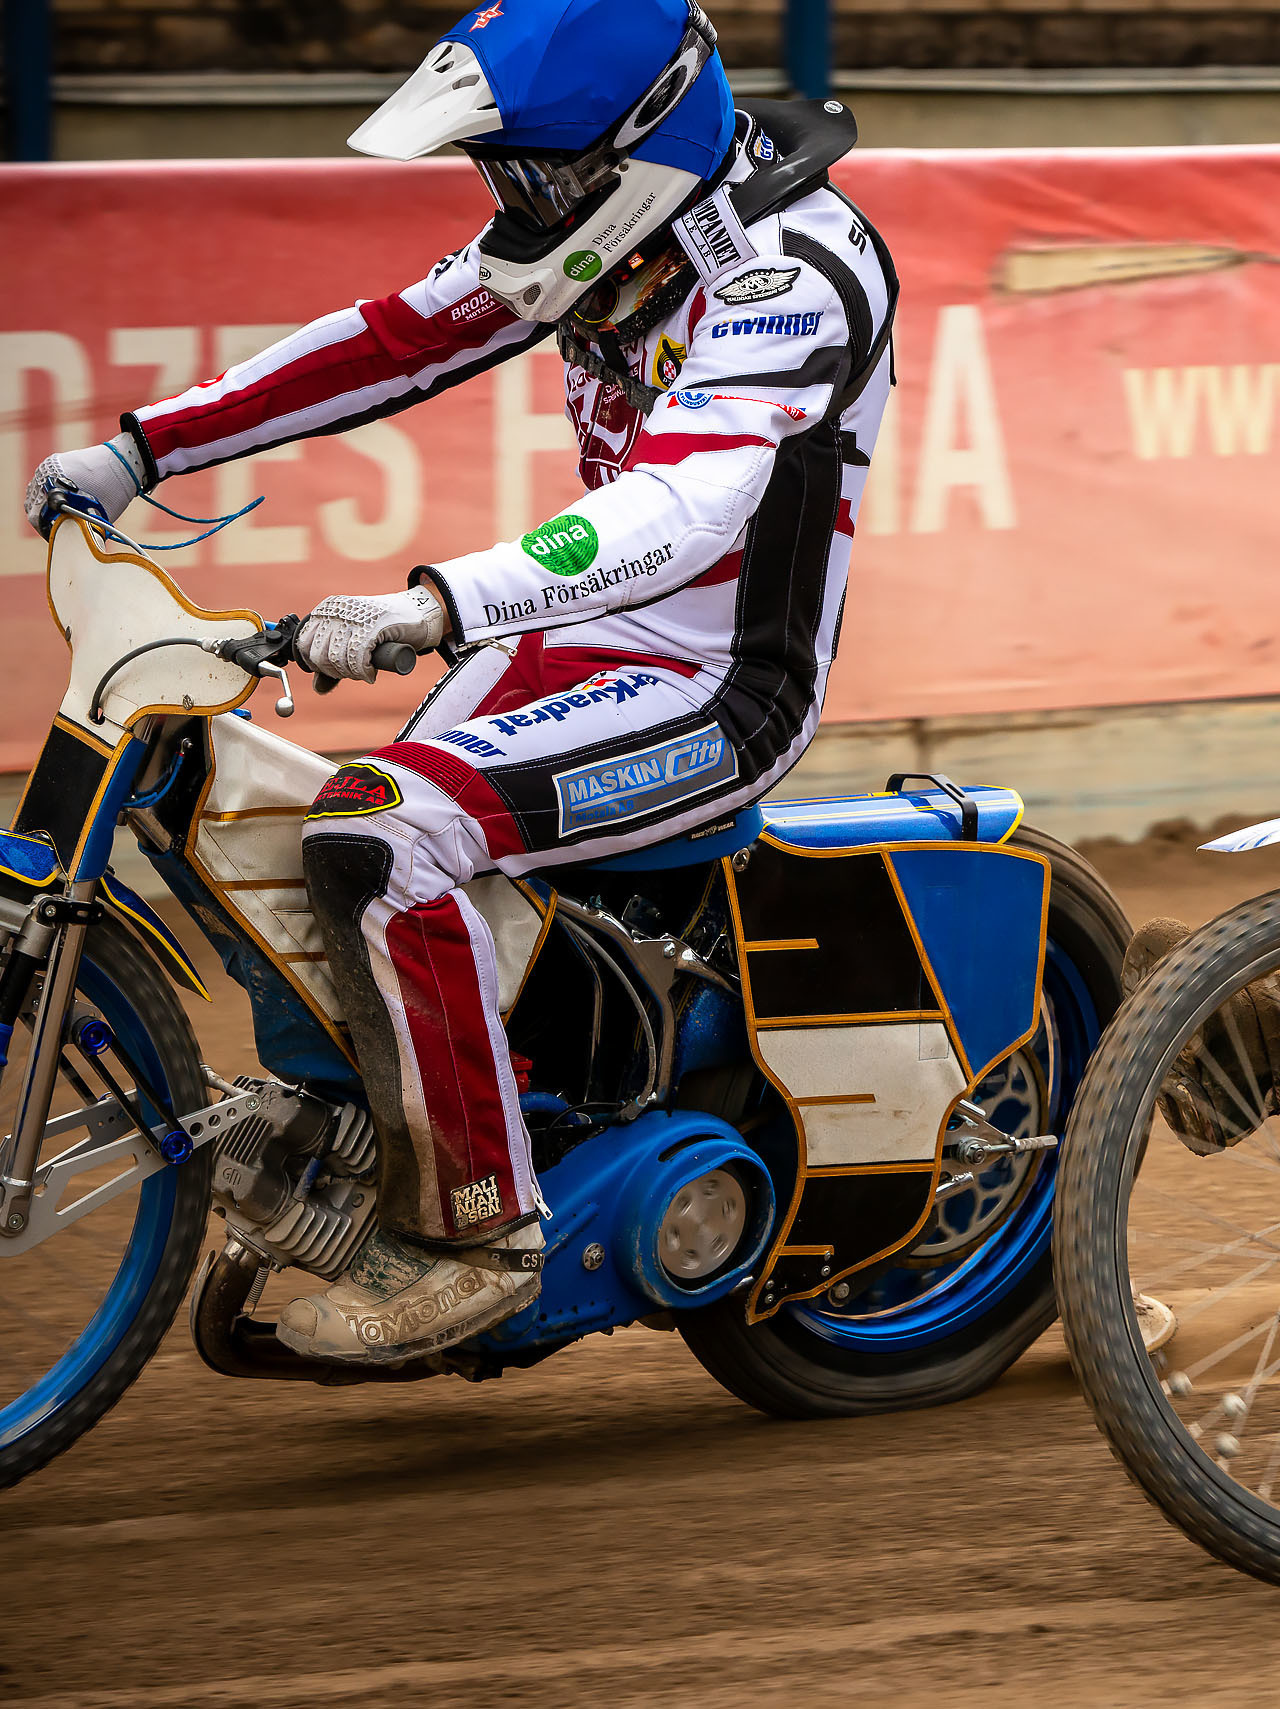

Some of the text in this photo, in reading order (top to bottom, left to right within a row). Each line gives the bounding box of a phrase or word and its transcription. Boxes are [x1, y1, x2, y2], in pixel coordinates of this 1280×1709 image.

[592, 223, 617, 246] Dina
[602, 192, 656, 253] Försäkringar
[570, 254, 596, 277] dina
[465, 300, 496, 320] MOTALA
[711, 309, 824, 339] ewinner
[531, 524, 590, 556] dina
[483, 542, 674, 627] Dina Försäkringar
[567, 737, 725, 804] MASKIN City
[364, 796, 385, 806] AB
[575, 805, 617, 825] Motala
[618, 800, 635, 815] AB
[453, 1175, 496, 1203] MALI
